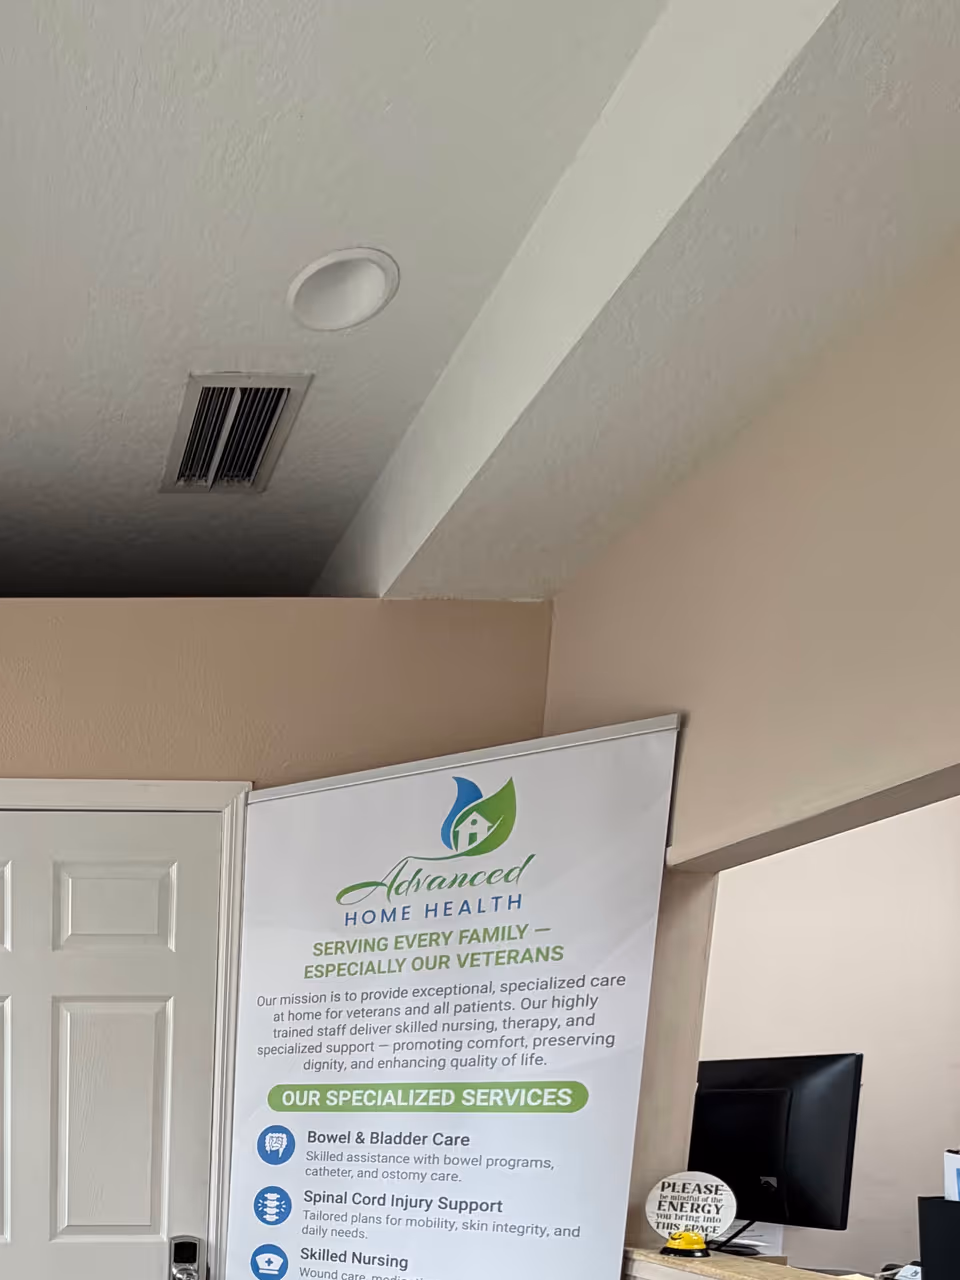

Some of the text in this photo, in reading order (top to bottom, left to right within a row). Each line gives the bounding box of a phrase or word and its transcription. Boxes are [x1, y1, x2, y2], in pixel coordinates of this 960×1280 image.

[335, 854, 537, 906] Advanced
[344, 893, 523, 927] HOME HEALTH
[312, 936, 389, 957] SERVING
[393, 930, 454, 951] EVERY
[458, 923, 530, 946] FAMILY
[303, 945, 565, 980] ESPECIALLY OUR VETERANS
[256, 973, 627, 1007] Our mission is to provide exceptional, specialized care
[273, 992, 599, 1023] at home for veterans and all patients. Our highly
[272, 1012, 596, 1039] trained staff deliver skilled nursing, therapy, and
[257, 1041, 323, 1058] specialized
[325, 1041, 375, 1056] support
[392, 1037, 464, 1055] promoting
[466, 1034, 529, 1050] comfort,
[531, 1031, 616, 1051] preserving
[303, 1052, 547, 1073] dignity, and enhancing quality of life.
[281, 1088, 573, 1107] OUR SPECIALIZED SERVICES
[307, 1130, 471, 1147] Bowel & Bladder Care
[305, 1150, 555, 1171] Skilled assistance with bowel programs,
[304, 1165, 463, 1184] catheter, and ostomy care.
[660, 1181, 725, 1196] PLEASE
[670, 1194, 700, 1202] mindful
[303, 1189, 504, 1215] Spinal Cord Injury Support
[657, 1200, 725, 1215] ENERGY
[302, 1209, 581, 1239] Tailored plans for mobility, skin integrity, and
[655, 1221, 681, 1231] THIS
[656, 1212, 721, 1223] you bring into
[301, 1223, 368, 1240] daily needs.
[299, 1247, 409, 1273] Skilled Nursing
[299, 1266, 339, 1280] Wound
